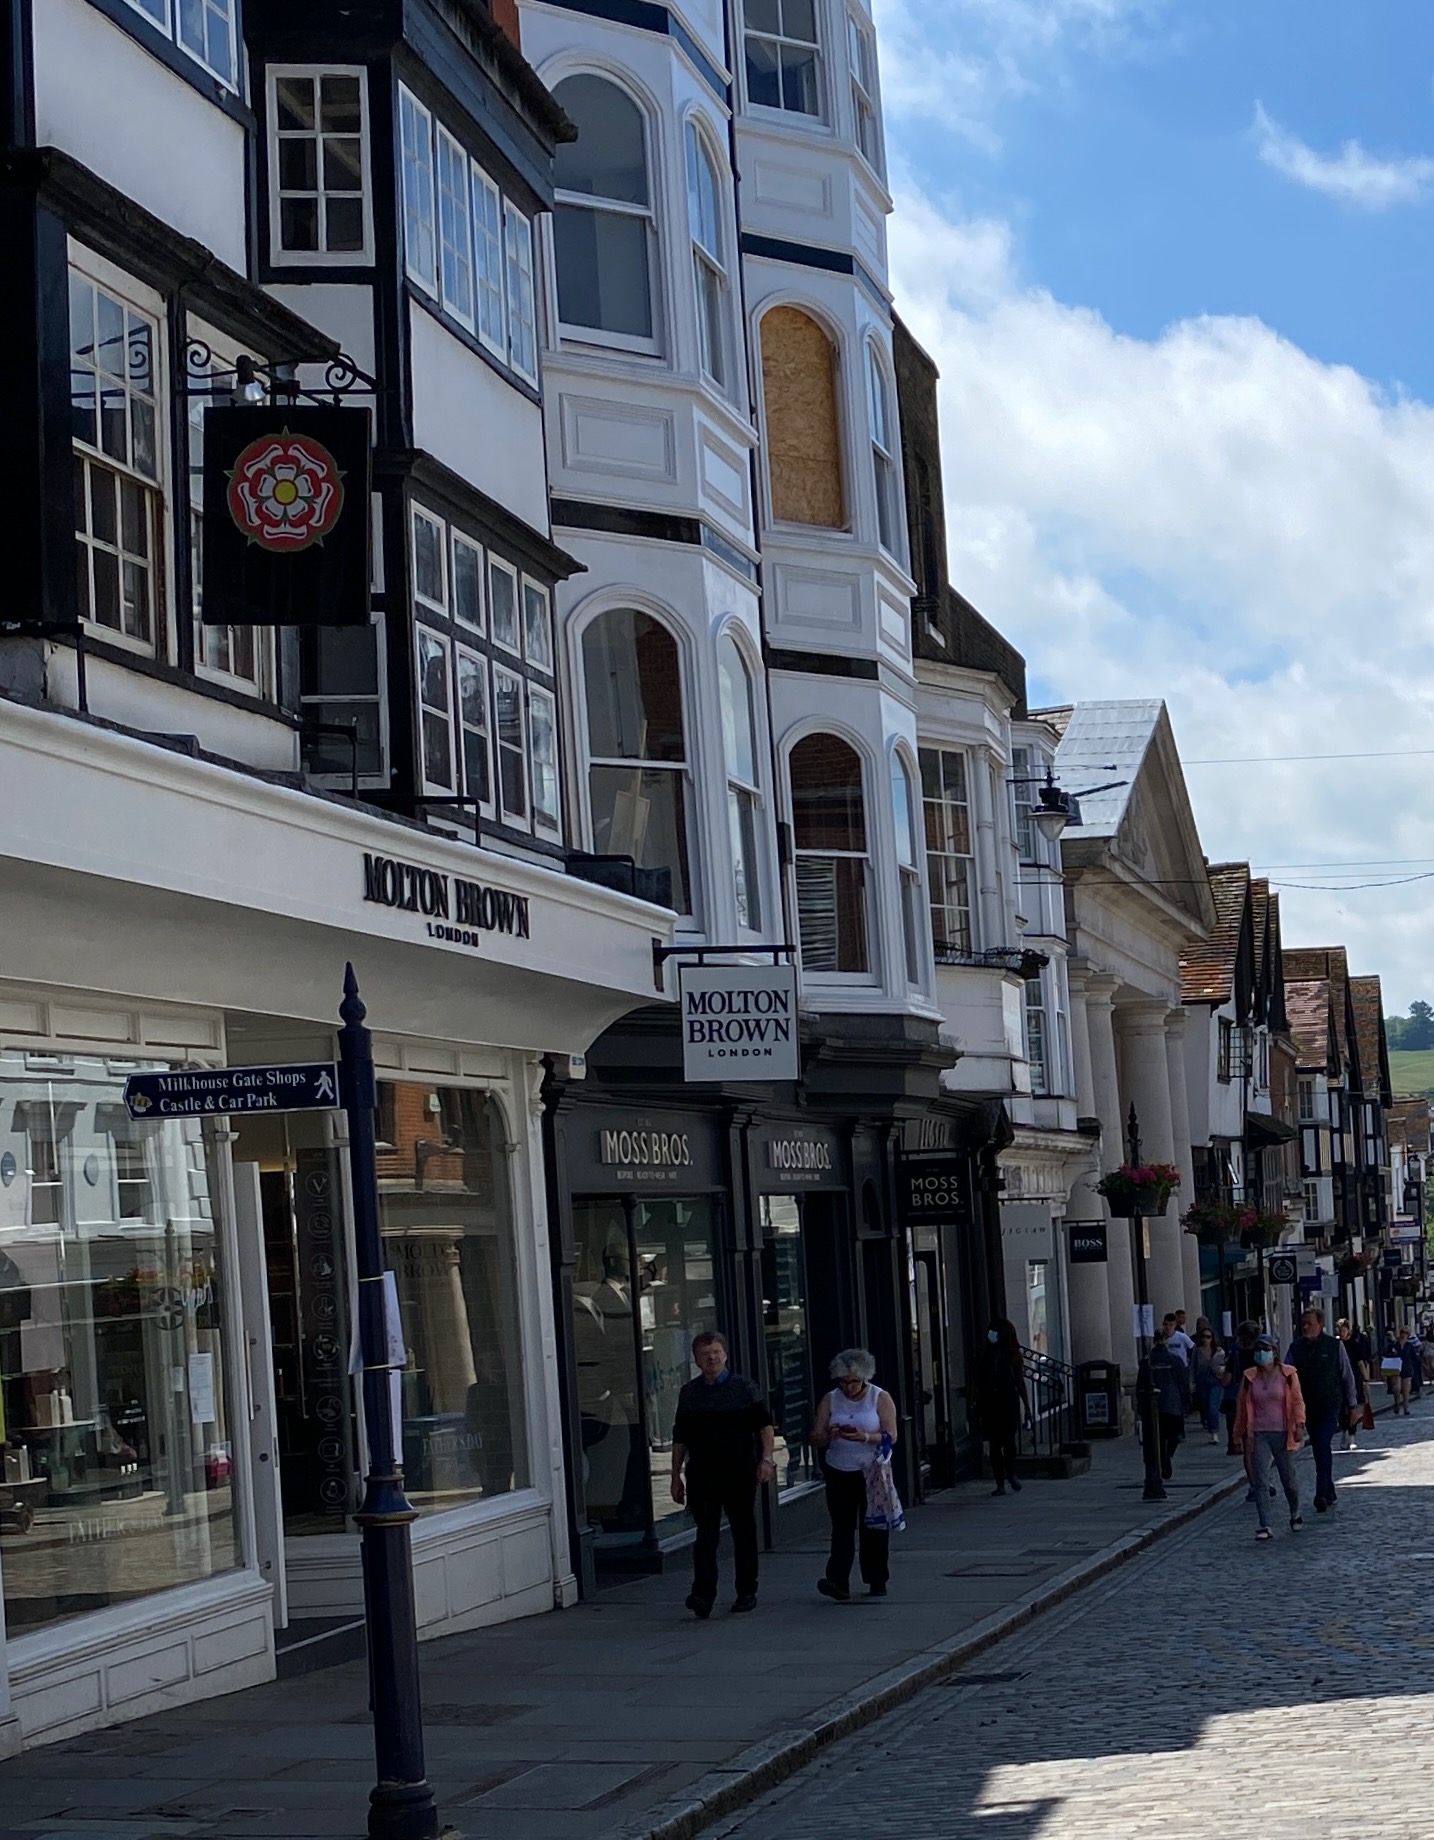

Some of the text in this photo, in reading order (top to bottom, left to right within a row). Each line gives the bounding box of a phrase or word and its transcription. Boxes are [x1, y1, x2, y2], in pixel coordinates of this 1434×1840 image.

[363, 853, 530, 940] MOLTON BROWN
[427, 922, 479, 947] LONDON
[686, 989, 791, 1015] MOLTON
[687, 1017, 792, 1043] BROWN
[708, 1048, 773, 1057] LONDON
[158, 1070, 306, 1092] Milkhouse Gate Shops
[159, 1092, 278, 1112] Castle & Car Park
[605, 1130, 694, 1166] MOSS BROS.
[773, 1140, 802, 1169] MOSS
[911, 1176, 959, 1191] MOSS
[1001, 1226, 1047, 1237] JIGSAW
[1074, 1239, 1104, 1249] BOSS
